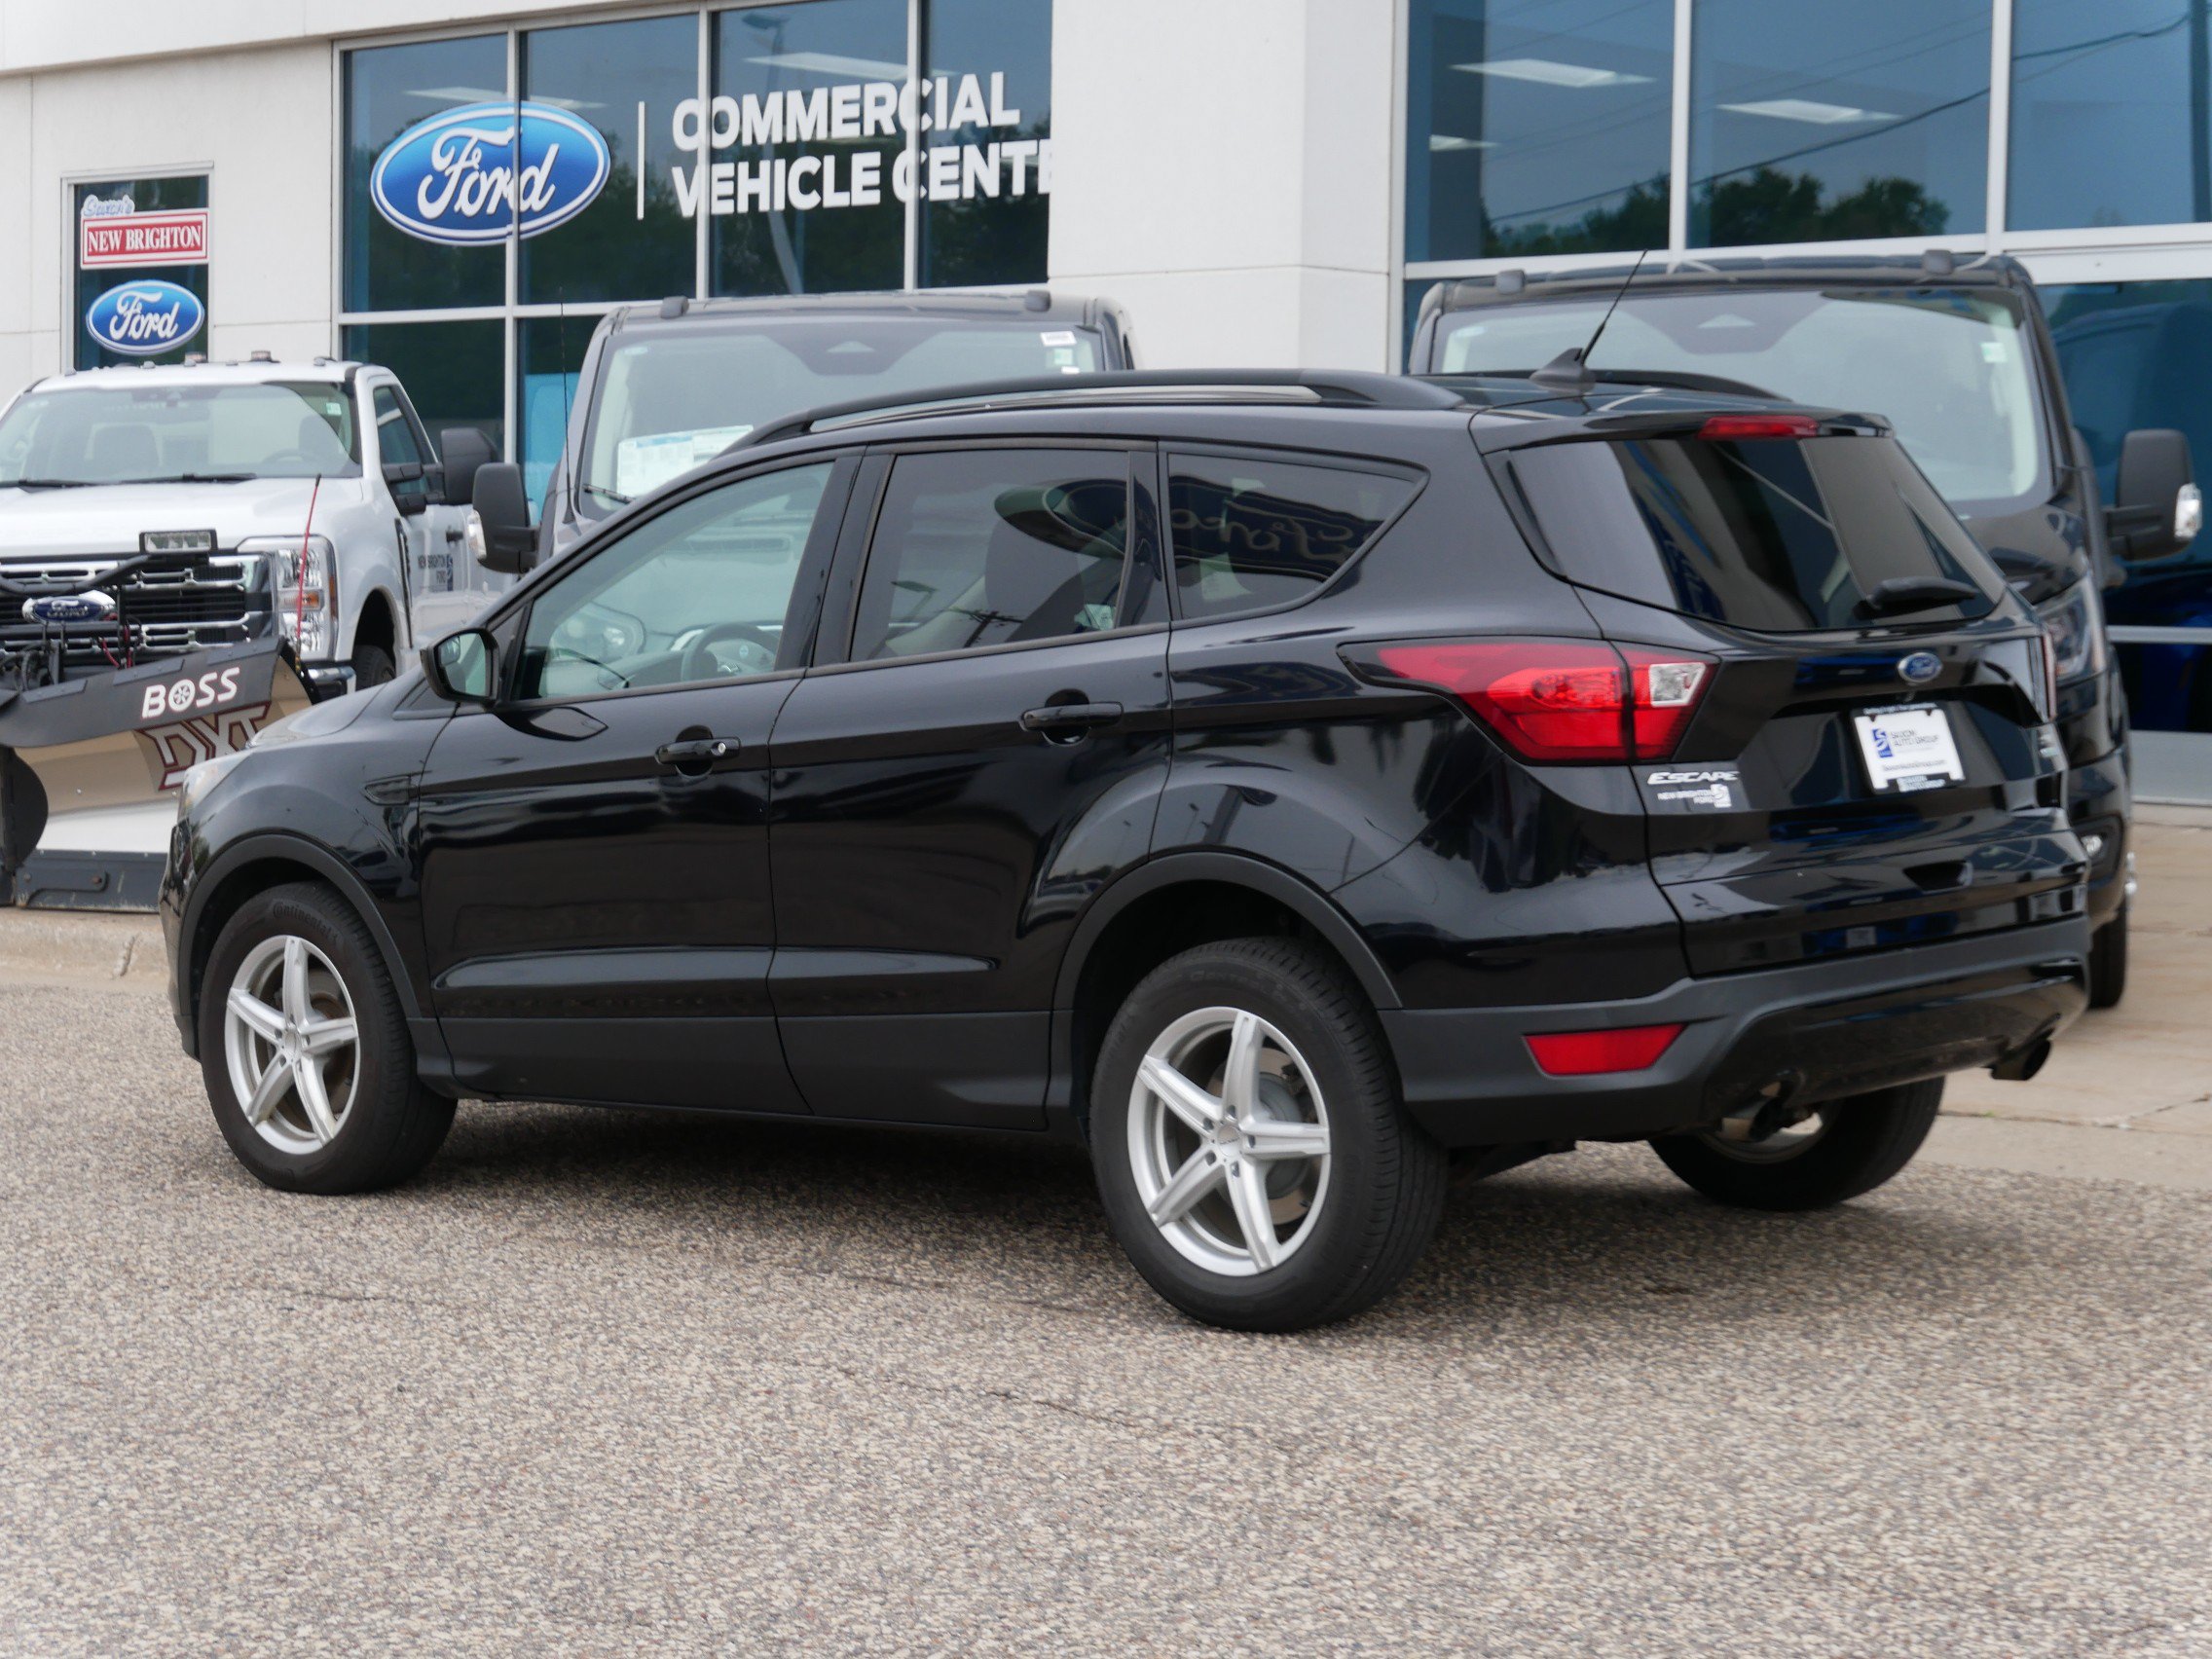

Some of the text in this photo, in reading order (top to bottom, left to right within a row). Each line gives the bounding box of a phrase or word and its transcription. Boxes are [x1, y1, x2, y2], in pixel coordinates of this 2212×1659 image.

[672, 71, 1021, 152] COMMERCIAL
[417, 126, 560, 220] Ford
[672, 152, 882, 219] VEHICLE
[88, 225, 203, 253] NEW BRIGHTON
[109, 290, 181, 341] Ford
[141, 667, 240, 719] BOSS
[133, 701, 272, 791] DXT
